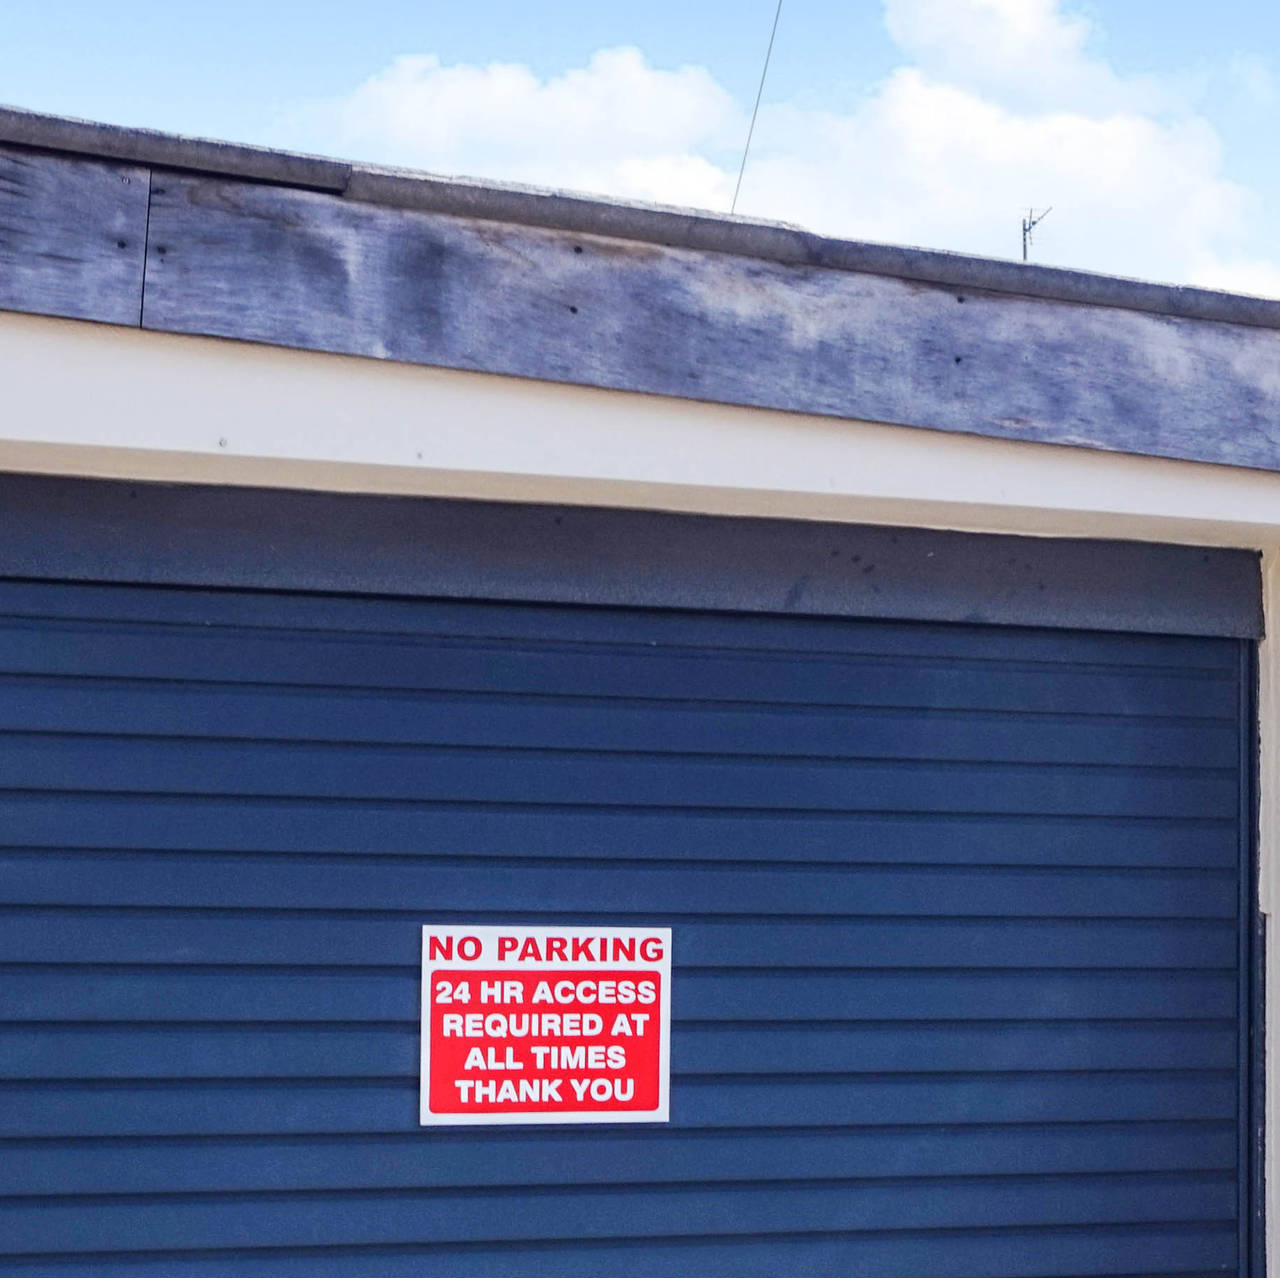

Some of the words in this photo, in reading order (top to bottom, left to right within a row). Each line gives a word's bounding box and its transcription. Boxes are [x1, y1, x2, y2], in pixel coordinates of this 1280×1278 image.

[429, 935, 483, 962] NO
[497, 936, 664, 963] PARKING
[435, 980, 471, 1004] 24
[480, 980, 524, 1004] HR
[531, 980, 656, 1005] ACCESS
[442, 1013, 603, 1038] REQUIRED
[610, 1013, 650, 1037] AT
[464, 1046, 524, 1070] ALL
[530, 1045, 626, 1070] TIMES
[454, 1078, 563, 1103] THANK
[570, 1078, 635, 1102] YOU
